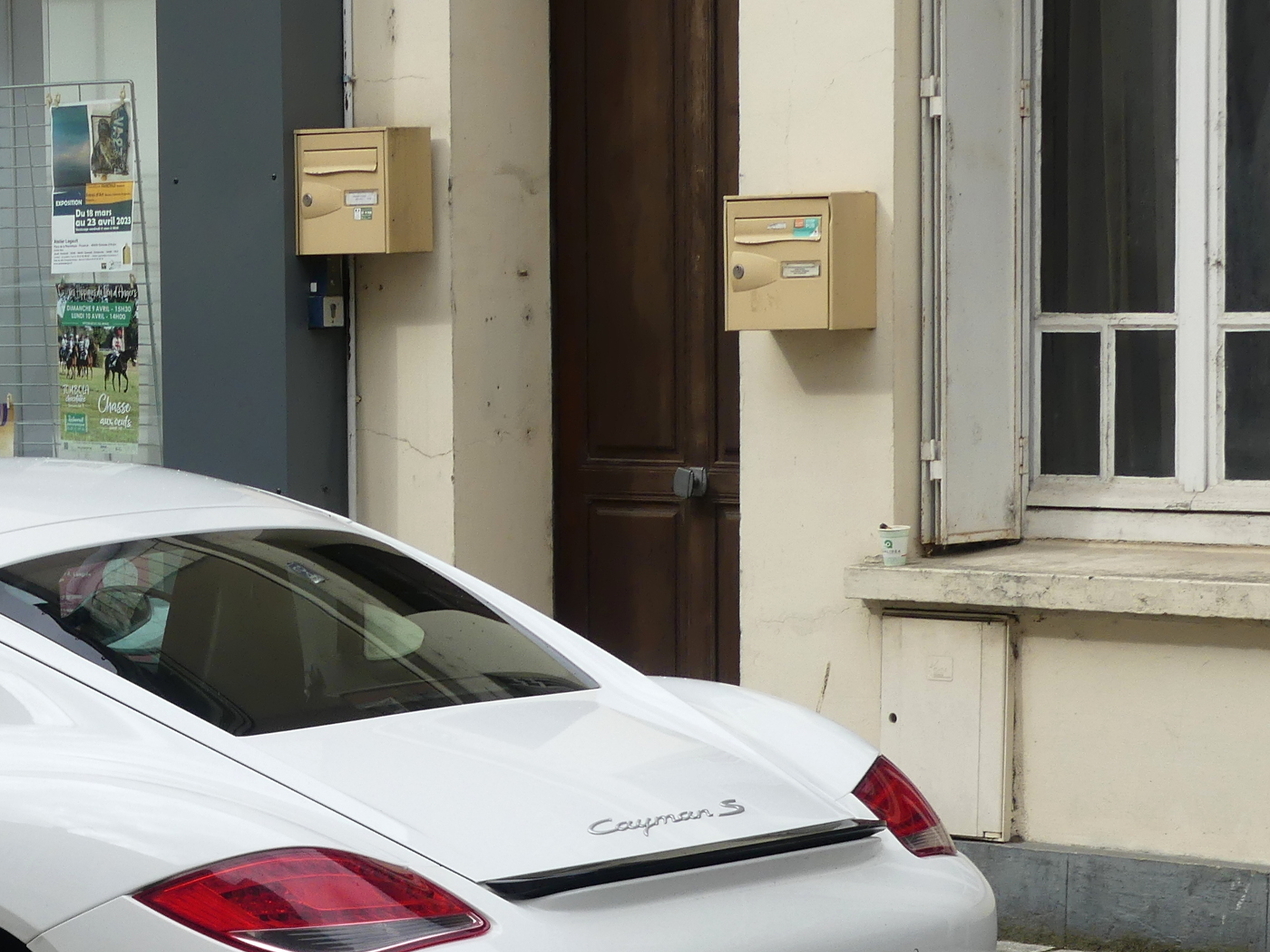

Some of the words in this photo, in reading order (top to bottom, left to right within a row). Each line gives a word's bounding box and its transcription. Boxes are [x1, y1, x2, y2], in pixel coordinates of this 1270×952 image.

[76, 209, 85, 217] Du
[87, 218, 96, 226] 23
[98, 216, 115, 226] avril
[116, 216, 131, 225] 2023
[98, 393, 131, 414] Chasse
[588, 808, 713, 836] Cayman
[718, 799, 745, 817] S
